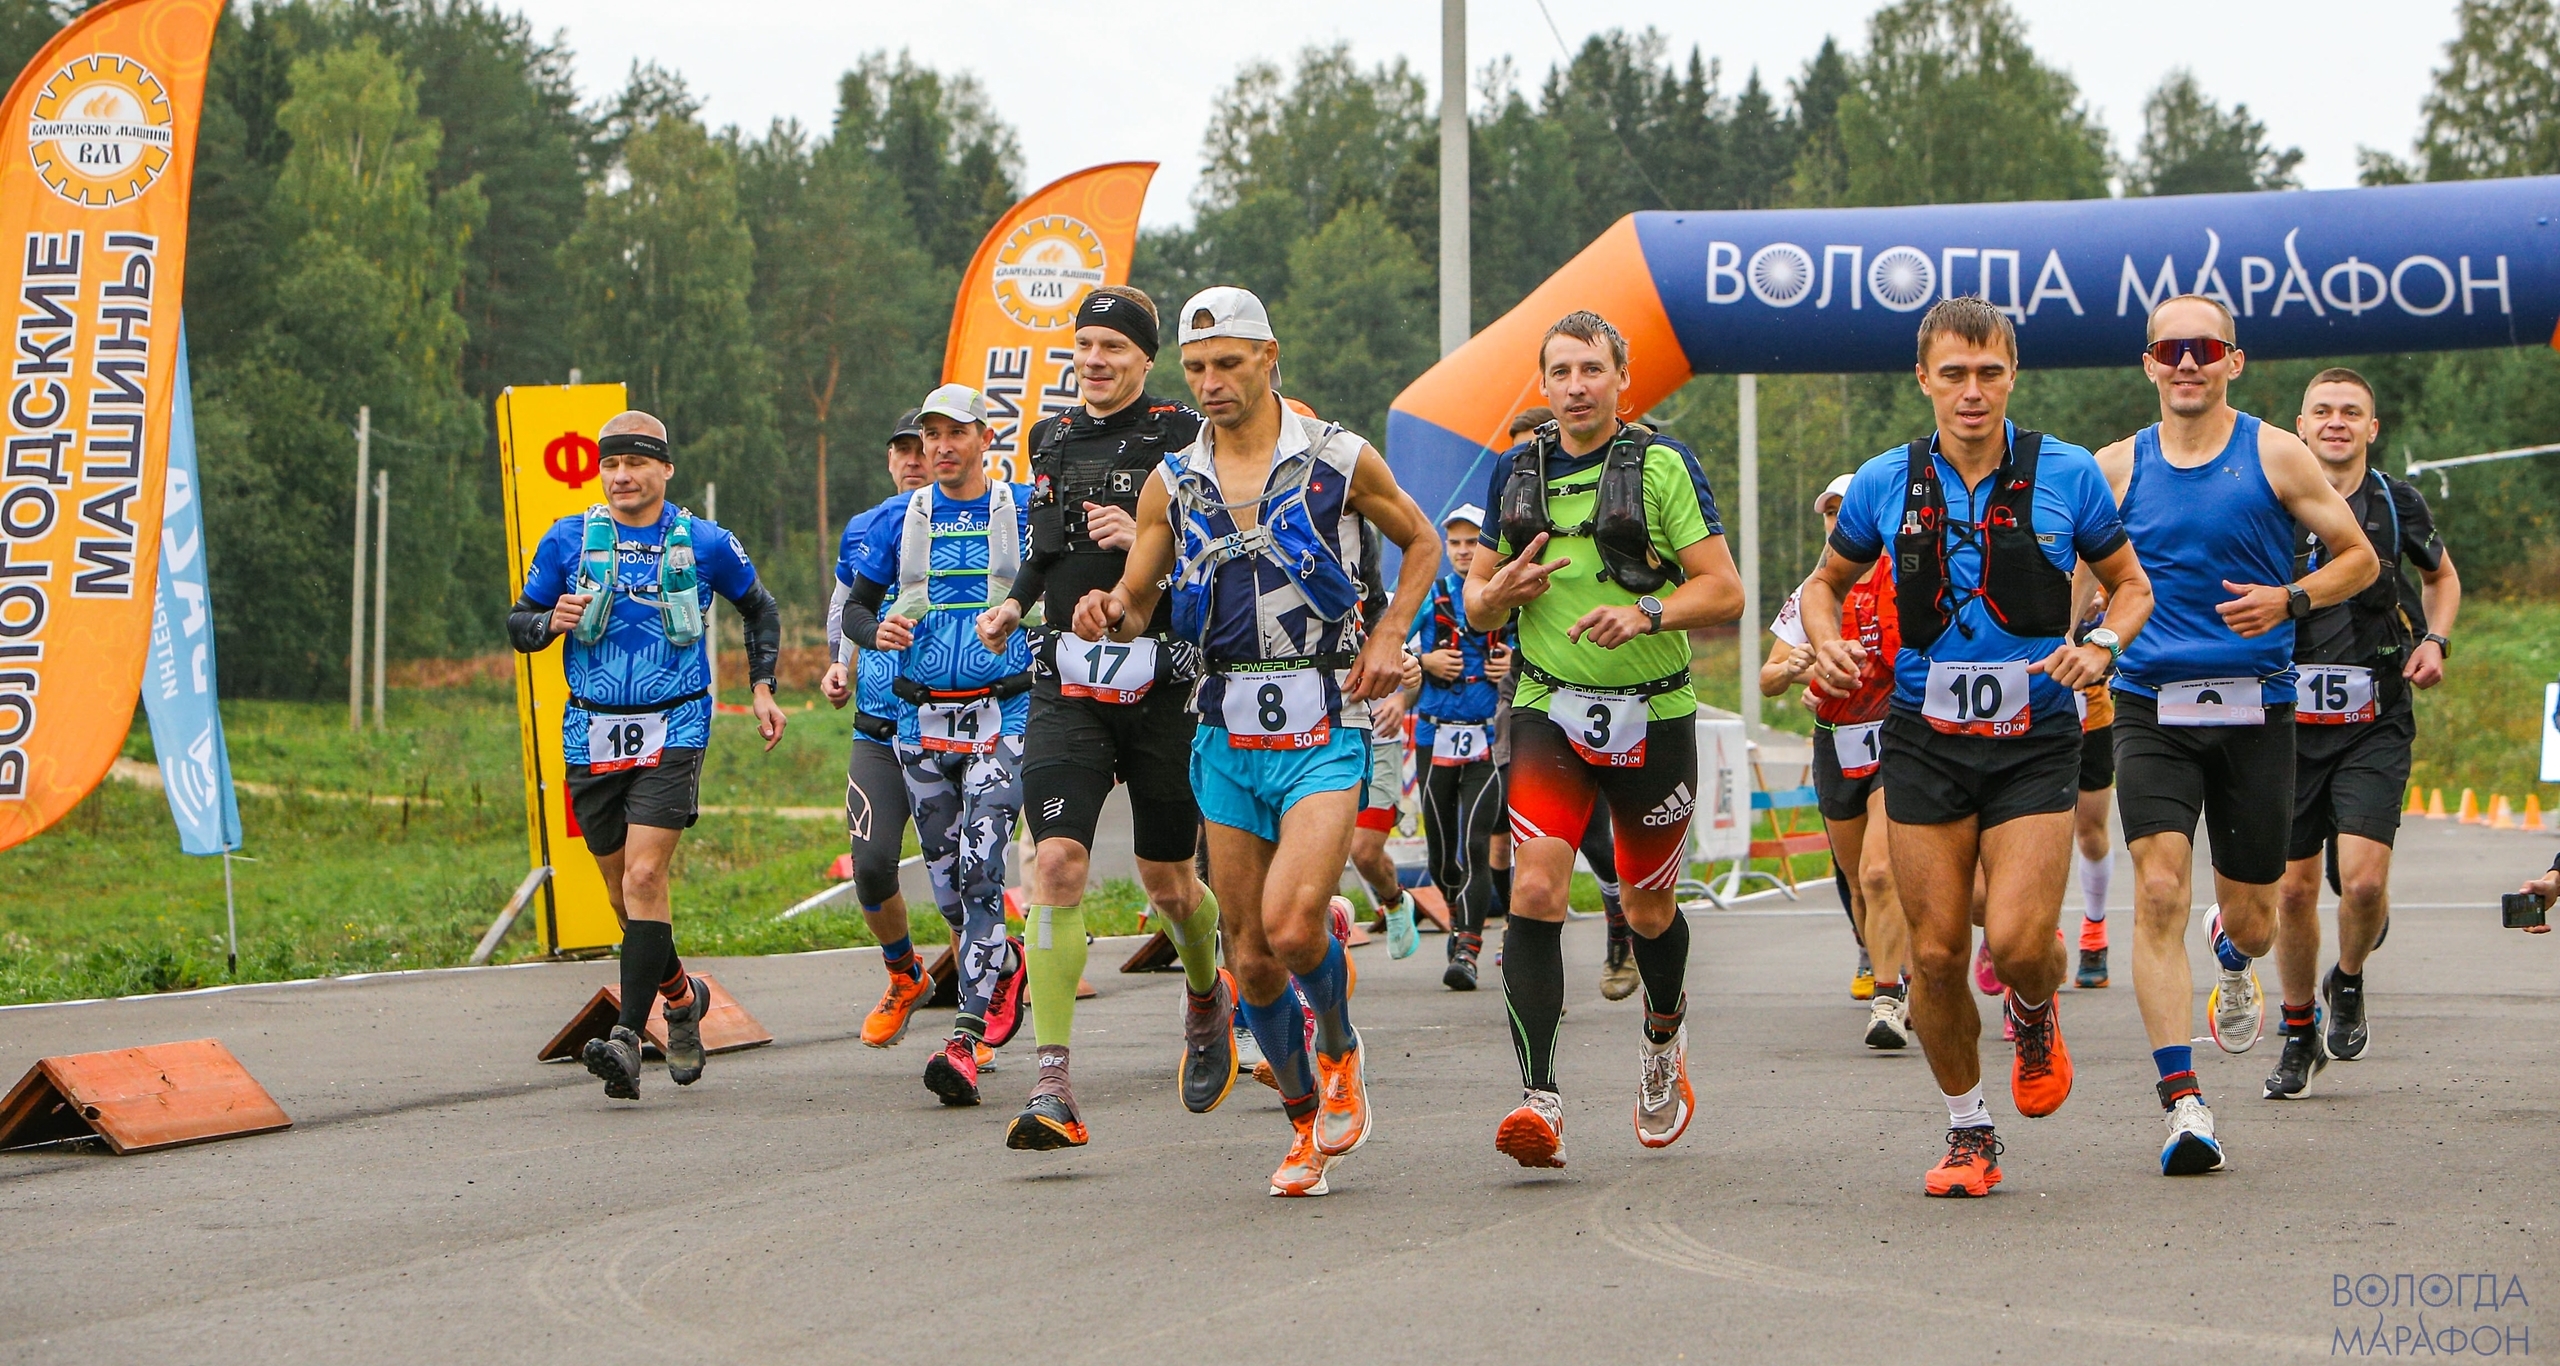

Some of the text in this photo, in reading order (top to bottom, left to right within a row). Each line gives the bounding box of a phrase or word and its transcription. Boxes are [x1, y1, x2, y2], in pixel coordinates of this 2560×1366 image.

[1706, 227, 2511, 325] ВОЛОГДА МАРАФОН
[75, 233, 157, 597] МАШИНЫ
[1084, 644, 1131, 685] 17
[1231, 659, 1310, 673] POWERUP
[1119, 691, 1136, 703] 50
[1949, 673, 2003, 719] 10
[2308, 673, 2349, 711] 15
[1257, 683, 1287, 732] 8
[2344, 713, 2359, 723] 50
[942, 710, 979, 740] 14
[1583, 703, 1612, 749] 3
[1993, 722, 2011, 735] 50
[607, 723, 644, 758] 18
[972, 743, 985, 753] 50
[1294, 733, 1313, 748] 50
[1451, 731, 1472, 757] 13
[1862, 730, 1877, 761] 1
[634, 757, 647, 766] 50
[1610, 754, 1628, 766] 50
[1642, 799, 1696, 826] adidas
